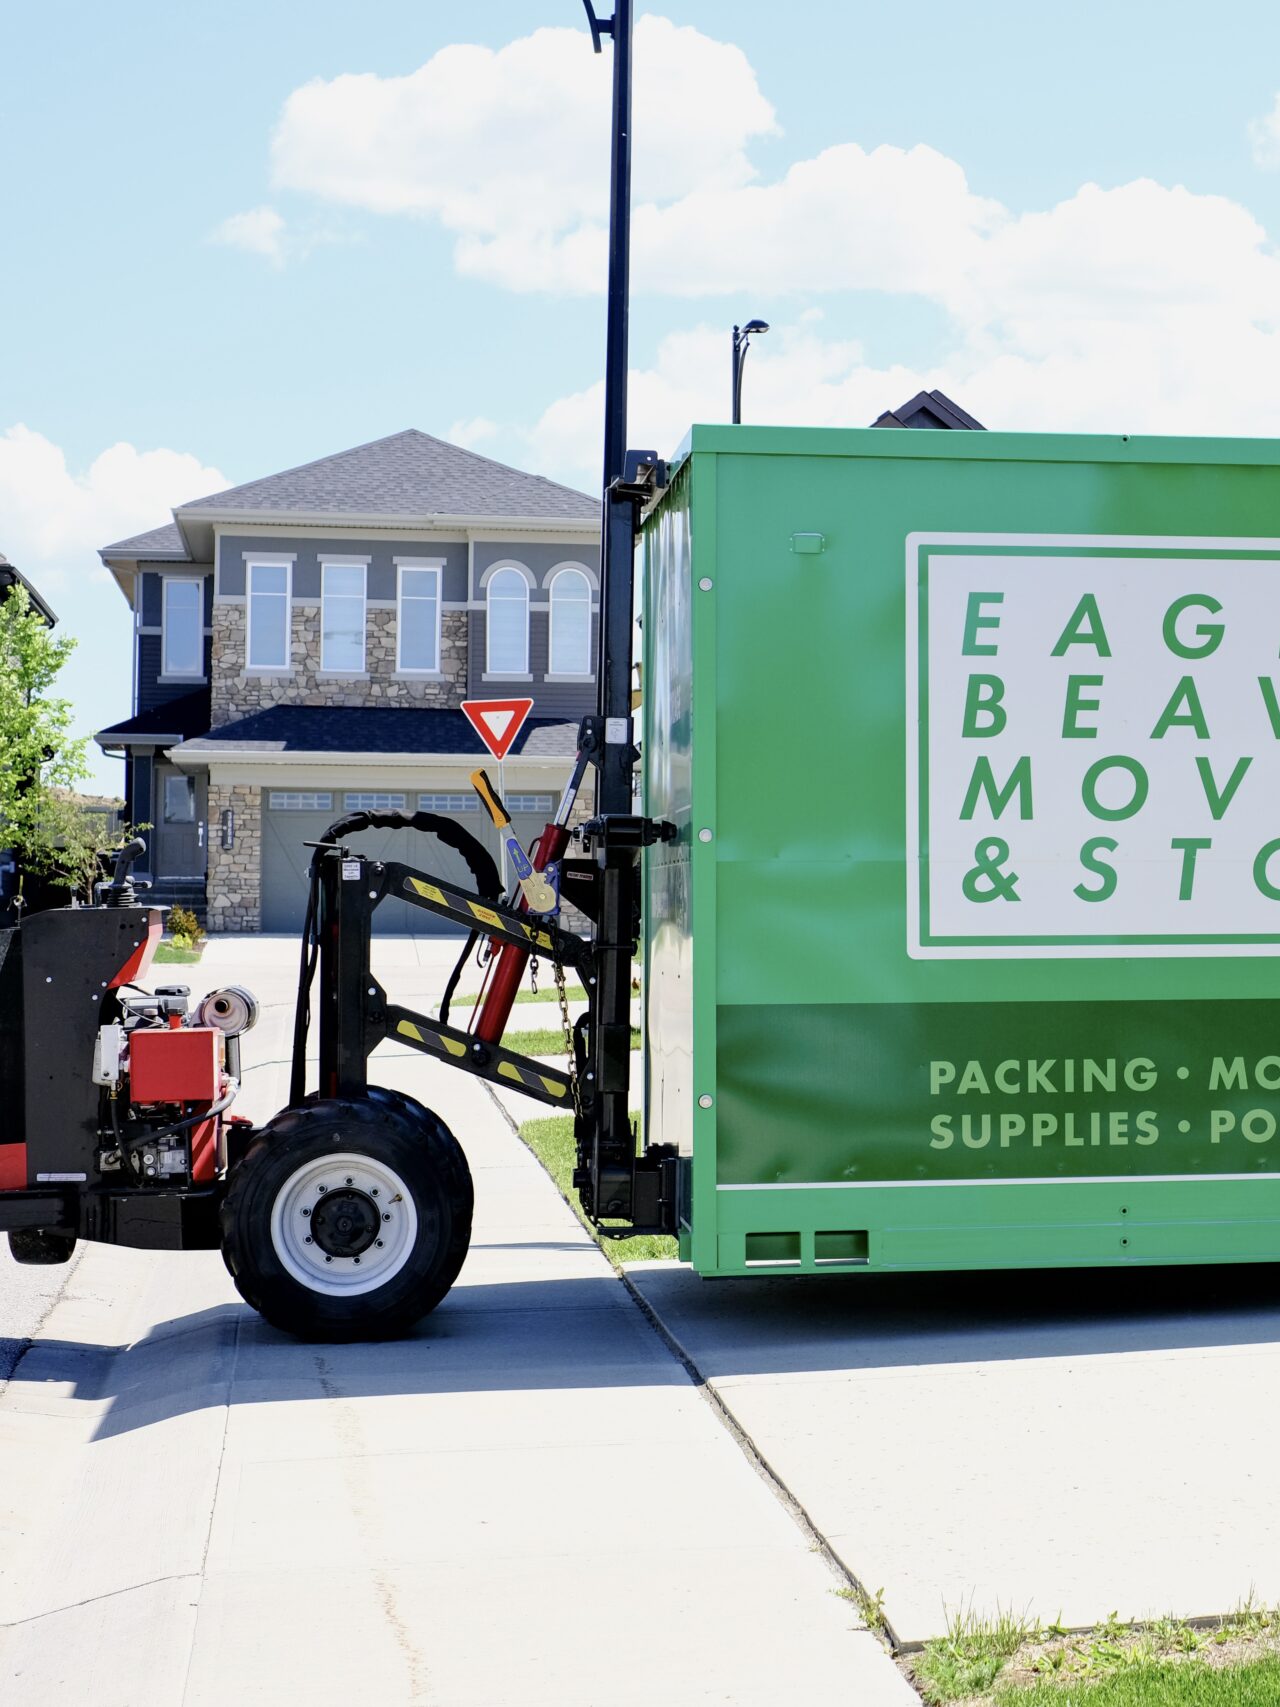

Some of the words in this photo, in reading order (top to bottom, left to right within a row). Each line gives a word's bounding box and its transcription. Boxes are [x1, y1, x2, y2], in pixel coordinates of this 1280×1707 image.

[961, 836, 1022, 904] &
[930, 1057, 1158, 1095] PACKING
[929, 1110, 1159, 1150] SUPPLIES
